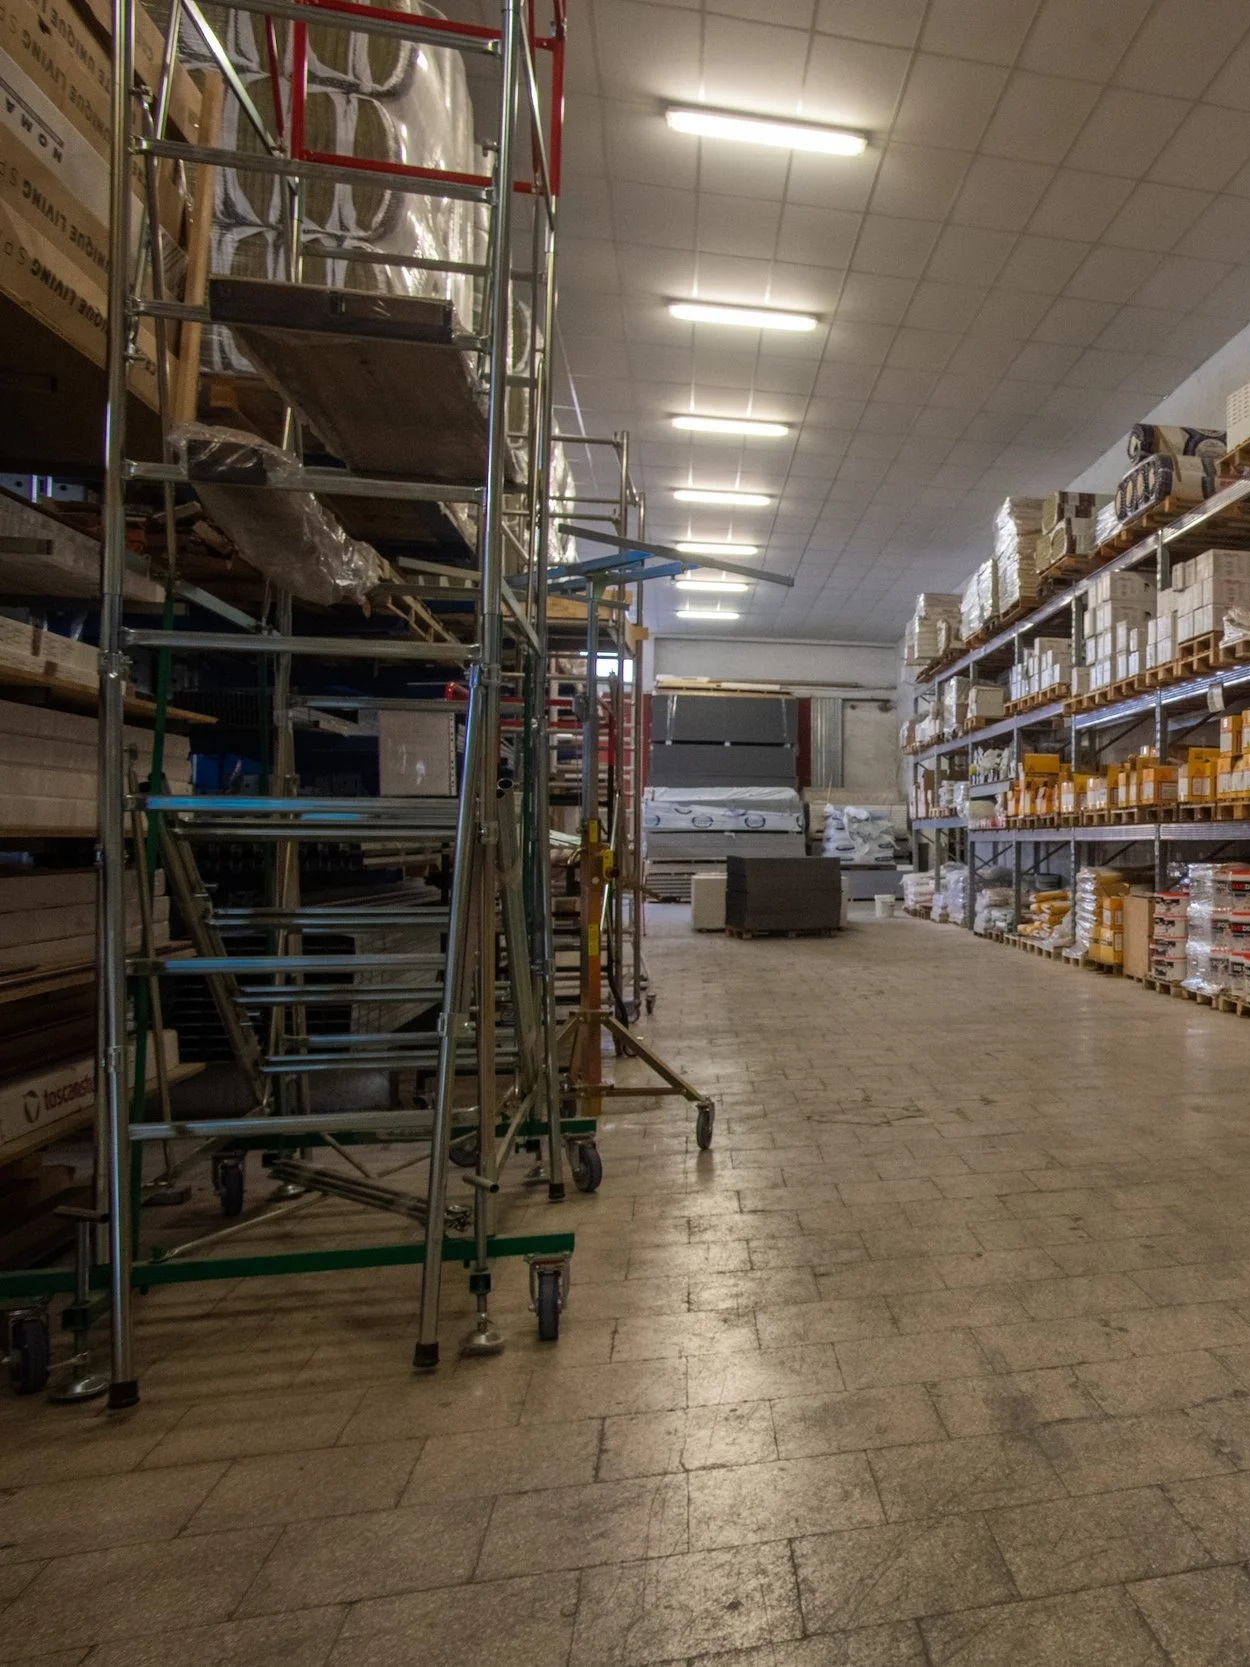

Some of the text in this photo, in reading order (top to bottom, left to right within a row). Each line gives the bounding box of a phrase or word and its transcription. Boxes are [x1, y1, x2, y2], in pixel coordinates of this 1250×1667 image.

[20, 29, 67, 93] LIVING
[5, 96, 64, 164] NOMA
[22, 183, 67, 233] LIVING
[29, 258, 77, 306] LIVING
